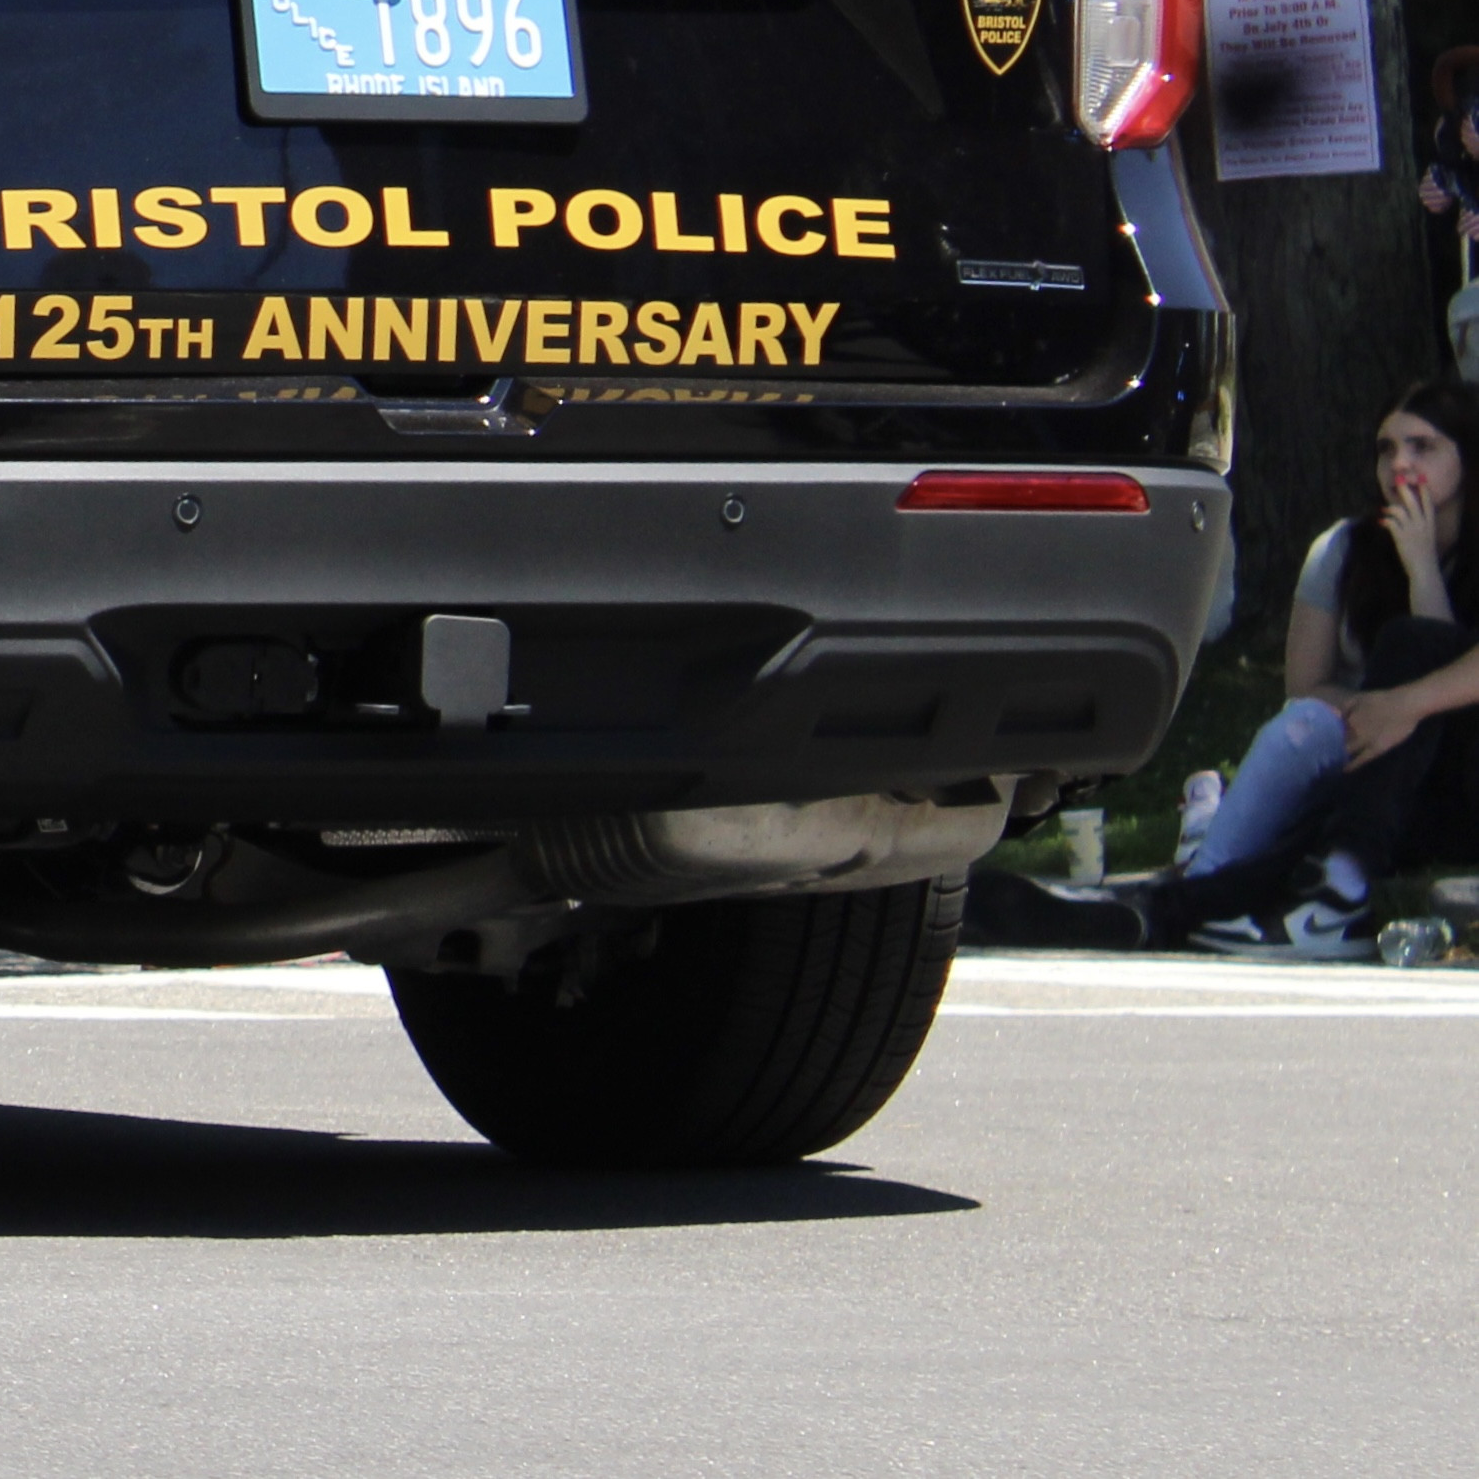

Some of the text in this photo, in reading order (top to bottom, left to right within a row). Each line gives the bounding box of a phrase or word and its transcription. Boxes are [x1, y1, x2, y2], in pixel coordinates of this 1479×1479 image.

[1229, 5, 1259, 20] Prior
[1264, 4, 1276, 15] To
[977, 15, 1026, 30] BRISTOL
[1244, 23, 1259, 36] On
[1263, 21, 1287, 35] July
[1294, 17, 1312, 29] 4th
[981, 30, 1022, 44] POLICE
[1251, 38, 1276, 51] Will
[1279, 37, 1296, 48] Be
[1300, 30, 1357, 45] Removed
[326, 72, 404, 95] RHODE
[489, 187, 896, 258] POLICE
[1050, 270, 1081, 283] AWD
[242, 296, 840, 366] ANNIVERSARY
